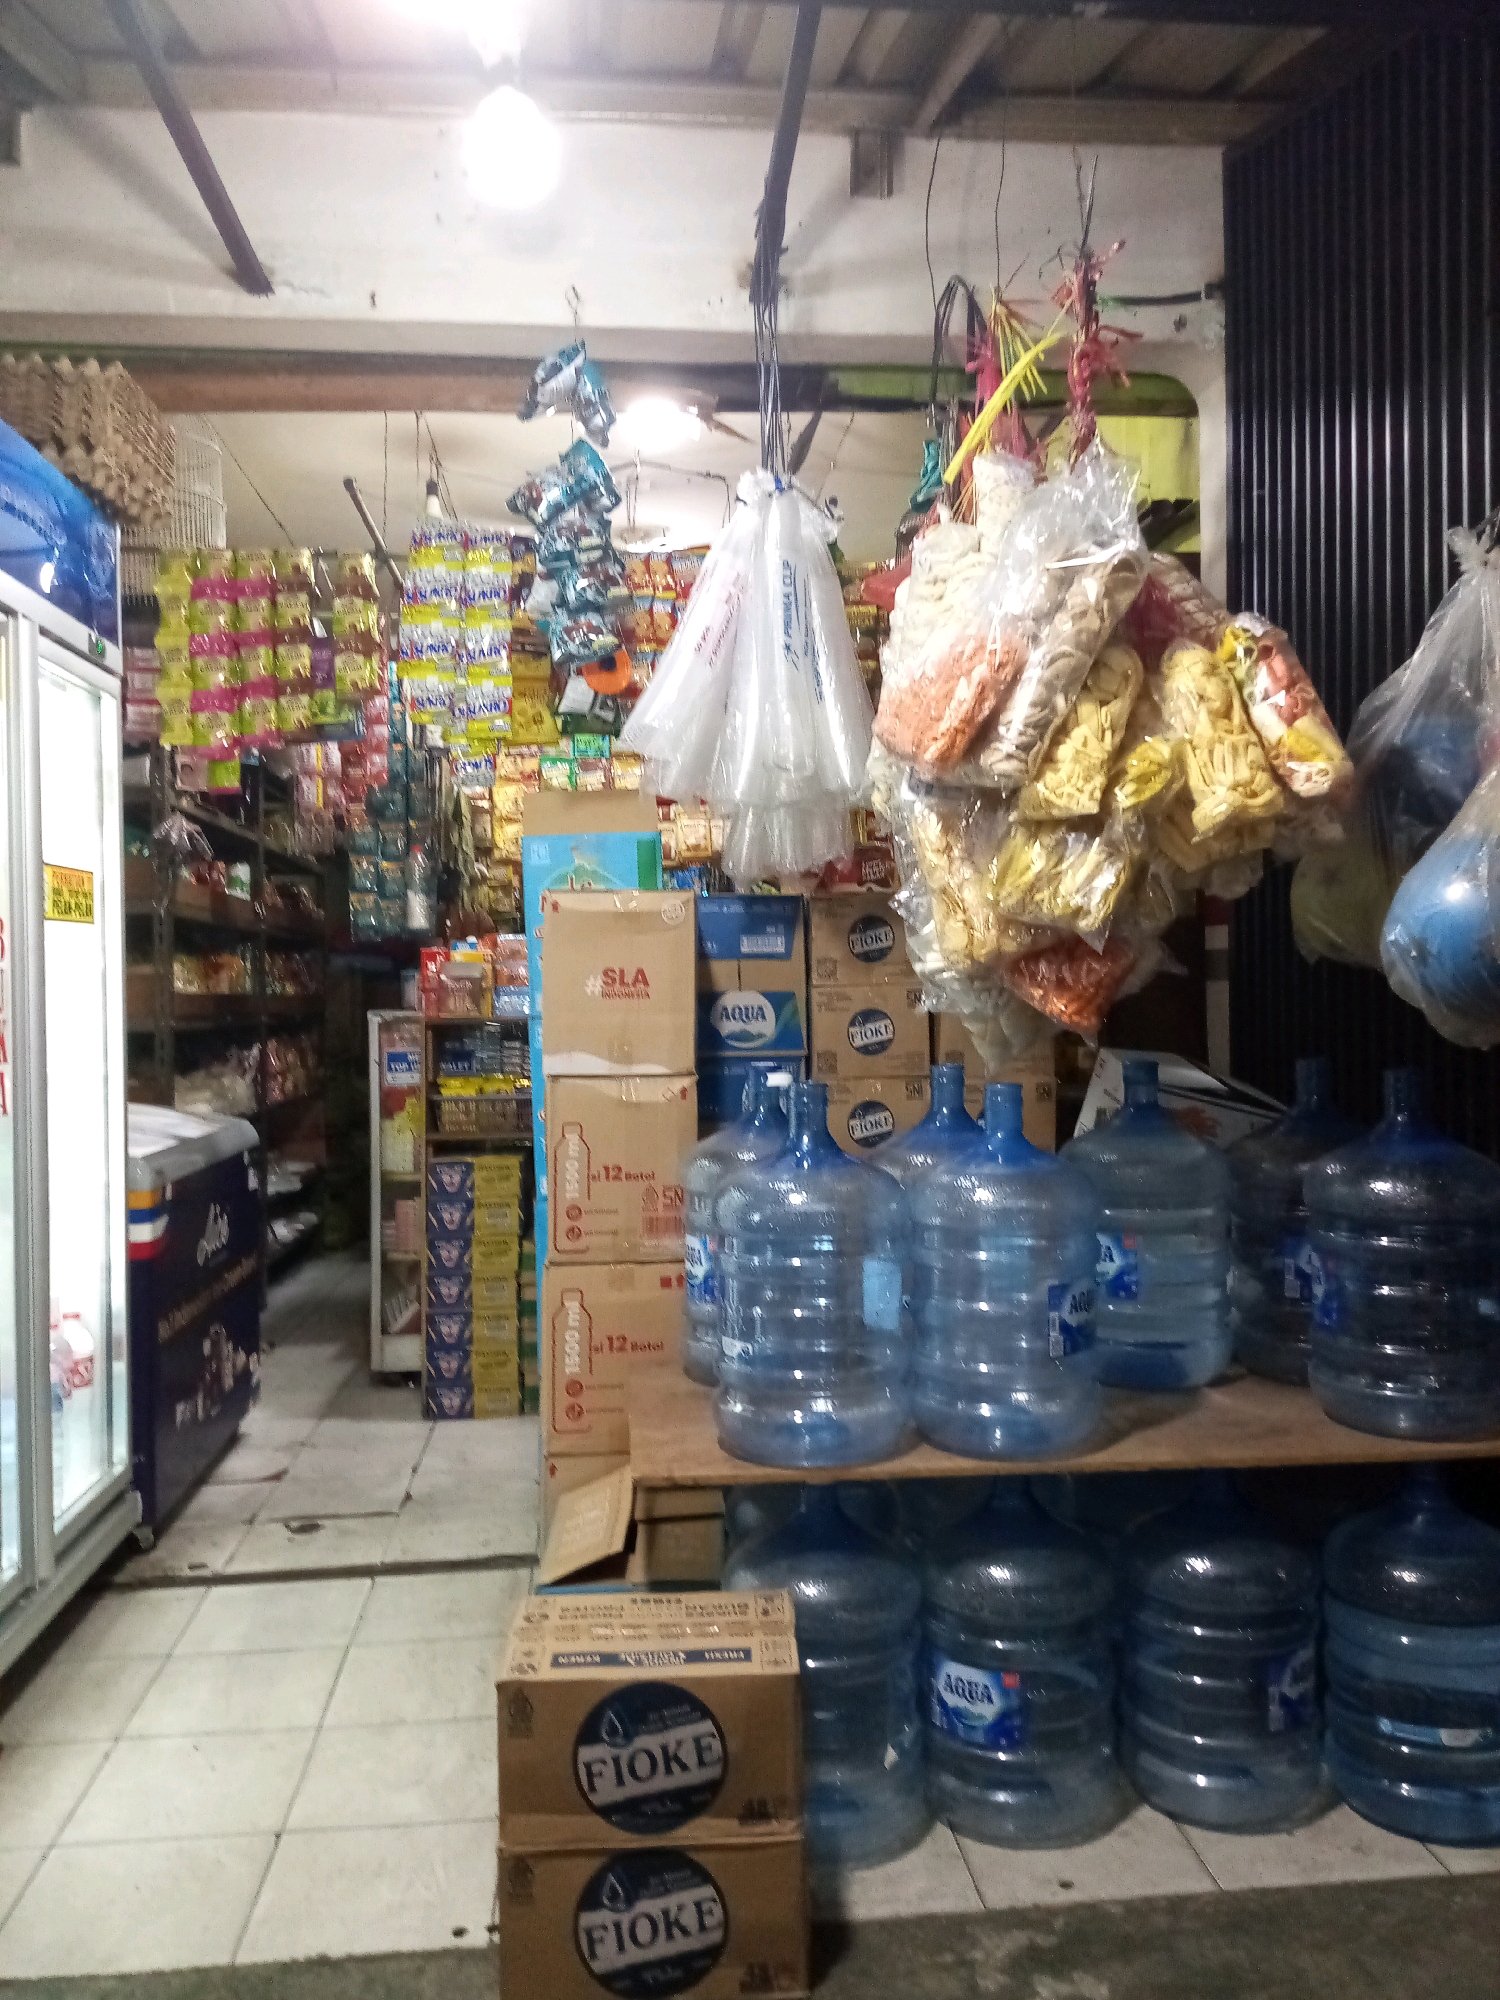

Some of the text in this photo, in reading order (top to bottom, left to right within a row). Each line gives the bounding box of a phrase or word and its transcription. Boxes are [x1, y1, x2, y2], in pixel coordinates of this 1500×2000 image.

[720, 1004, 768, 1024] AQUA
[602, 1164, 623, 1182] 12
[564, 1328, 581, 1376] 1500
[605, 1333, 628, 1354] 12
[943, 1671, 995, 1706] AQUA
[582, 1730, 723, 1795] FIOKE
[583, 1895, 724, 1961] FIOKE
